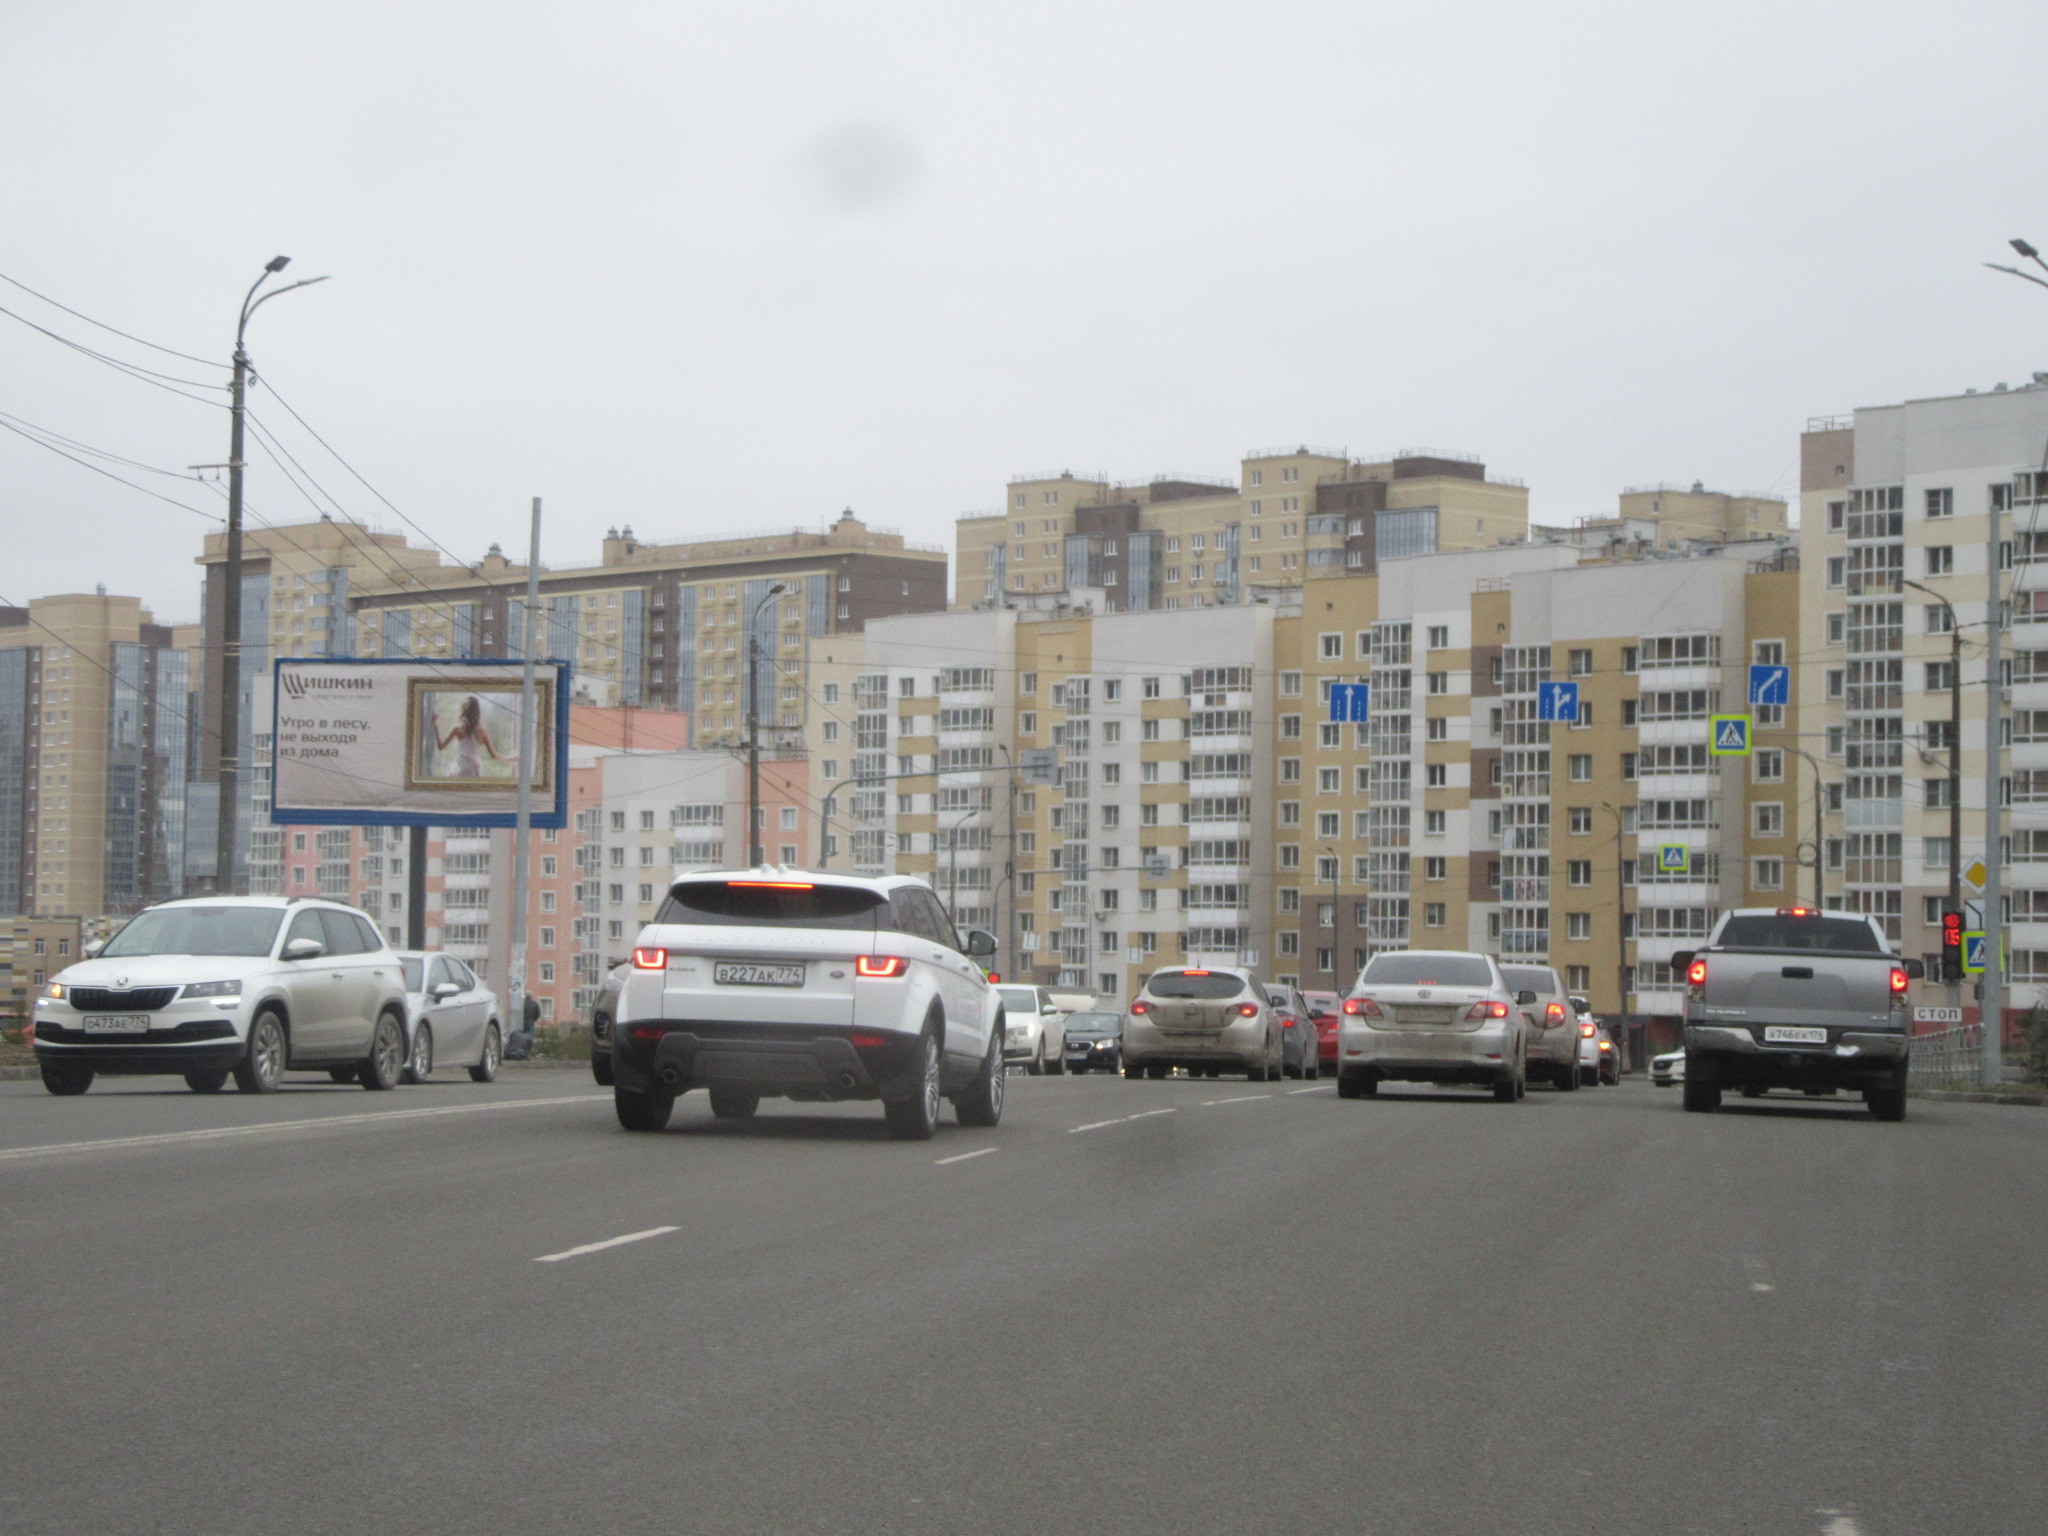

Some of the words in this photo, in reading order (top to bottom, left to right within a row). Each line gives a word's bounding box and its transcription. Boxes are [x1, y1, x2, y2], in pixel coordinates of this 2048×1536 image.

[281, 716, 315, 730] Утро
[319, 719, 328, 729] в
[280, 733, 297, 742] не
[301, 733, 357, 744] выходя
[280, 747, 296, 757] из
[300, 748, 339, 758] дома
[1918, 1009, 1958, 1020] СТОП
